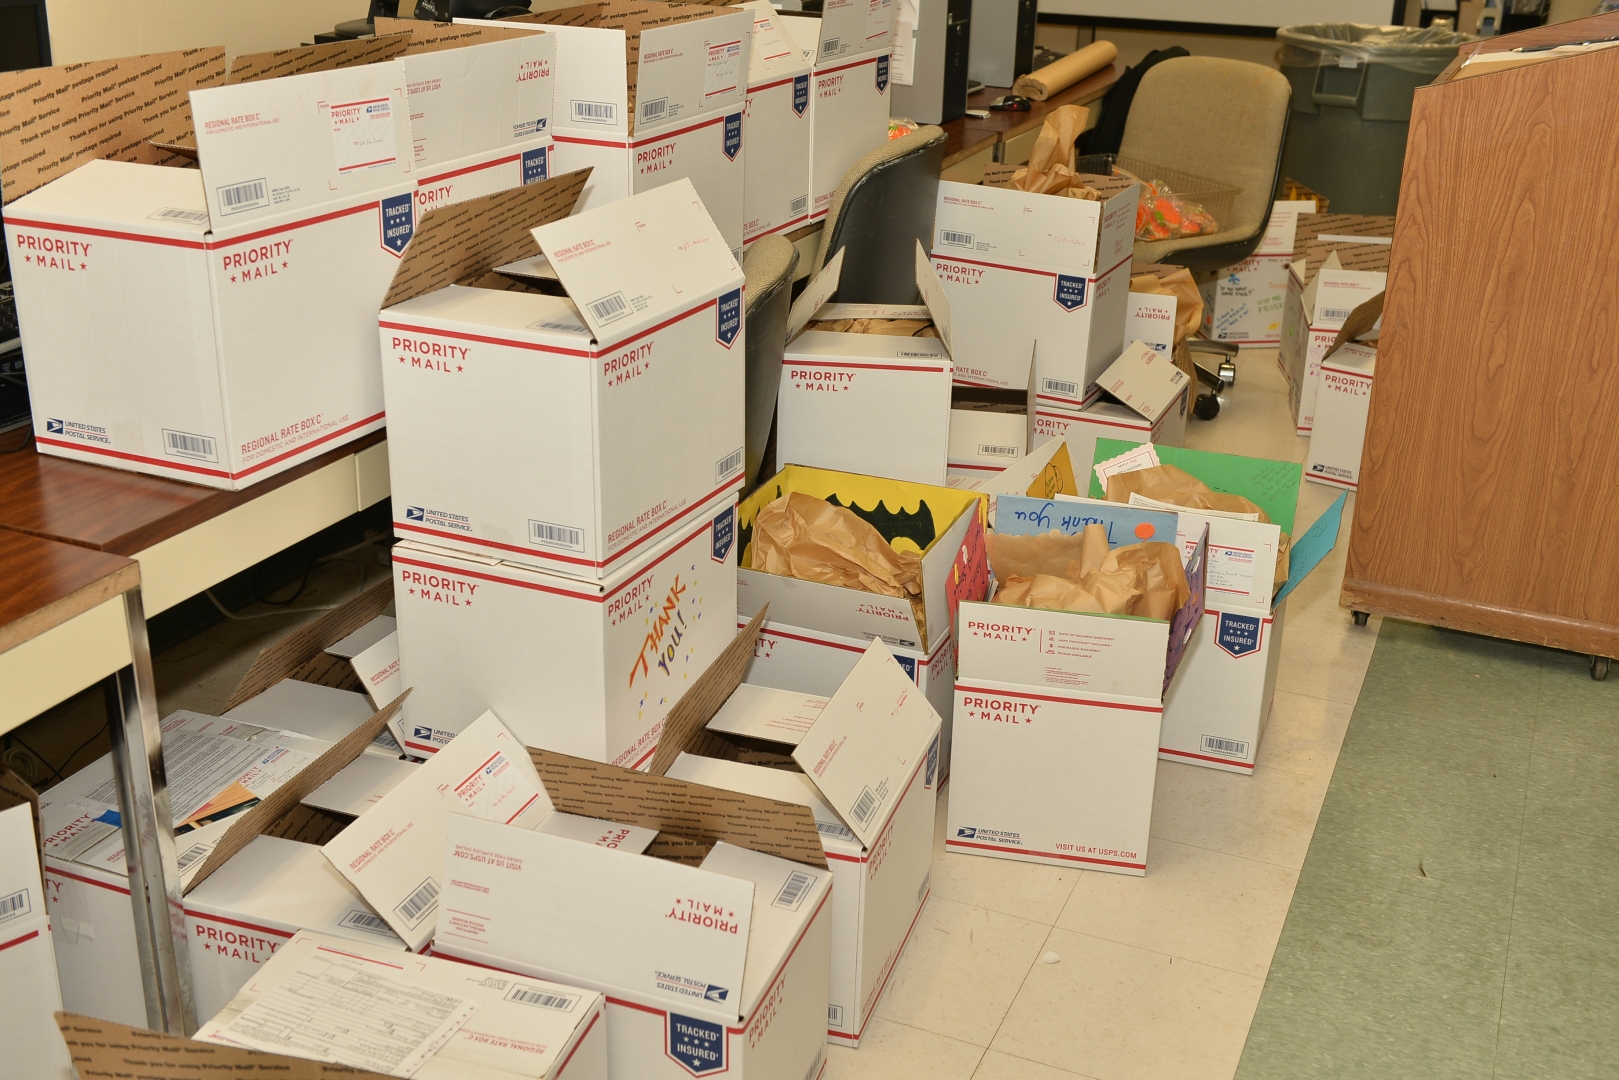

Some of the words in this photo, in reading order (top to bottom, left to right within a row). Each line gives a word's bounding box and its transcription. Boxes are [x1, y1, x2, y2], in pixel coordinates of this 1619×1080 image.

[526, 60, 542, 70] MAIL
[118, 74, 139, 88] postage
[140, 63, 162, 78] required
[517, 68, 550, 82] PRIORITY
[818, 75, 844, 90] PRIORITY
[16, 80, 42, 95] required
[33, 92, 55, 105] Priority
[72, 75, 94, 90] postage
[96, 64, 118, 78] required
[824, 90, 837, 98] MAIL
[20, 133, 39, 146] Thank
[78, 106, 99, 120] Priority
[114, 91, 135, 104] Service
[38, 108, 60, 120] Service
[69, 130, 87, 142] Thank
[124, 104, 144, 117] Priority
[158, 90, 178, 102] Service
[142, 113, 159, 124] Thank
[331, 108, 361, 118] PRIORITY
[205, 116, 230, 129] REGIONAL
[340, 117, 355, 126] MAIL
[726, 120, 740, 132] TRACKED
[21, 149, 46, 164] required
[38, 158, 59, 174] Priority
[76, 142, 98, 157] postage
[99, 130, 122, 146] required
[638, 143, 676, 164] PRIORITY
[525, 157, 545, 168] TRACKED
[646, 161, 666, 174] MAIL
[418, 186, 452, 206] ORITY
[386, 203, 410, 218] TRACKED
[386, 225, 412, 239] INSURED
[17, 234, 90, 257] PRIORITY
[223, 239, 293, 270] PRIORITY
[36, 254, 75, 271] MAIL
[242, 262, 278, 284] MAIL
[936, 263, 984, 278] PRIORITY
[946, 274, 972, 285] MAIL
[1061, 280, 1083, 288] TRACKED
[1060, 292, 1082, 302] INSURED
[720, 299, 738, 312] TRACKED
[720, 318, 739, 328] INSURED
[1134, 312, 1170, 321] PRIORITY
[393, 337, 468, 360] PRIORITY
[412, 356, 450, 373] MAIL
[604, 343, 654, 376] PRIORITY
[616, 366, 642, 386] MAIL
[791, 370, 854, 382] PRIORITY
[956, 366, 971, 375] RATE
[971, 368, 982, 376] BOX
[806, 382, 838, 392] MAIL
[1325, 374, 1372, 390] PRIORITY
[1335, 385, 1359, 396] MAIL
[64, 420, 86, 430] UNITED
[86, 424, 106, 434] STATES
[1035, 418, 1070, 430] ORITY
[64, 430, 86, 440] POSTAL
[241, 434, 280, 454] REGIONAL
[280, 423, 300, 438] RATE
[300, 416, 316, 431] BOX
[242, 454, 255, 464] FOR
[256, 443, 284, 460] DOMESTIC
[284, 436, 296, 446] AND
[298, 420, 338, 440] INTERNATIONAL
[338, 414, 349, 424] USE
[425, 518, 447, 528] POSTAL
[426, 509, 448, 518] UNITED
[448, 513, 469, 522] STATES
[608, 521, 636, 544] REGIONAL
[636, 511, 650, 526] RATE
[651, 504, 662, 519] BOX
[618, 528, 638, 546] DOMESTIC
[648, 505, 678, 526] INTERNATIONAL
[715, 515, 732, 532] TRACKED
[715, 532, 732, 550] INSURED
[402, 570, 476, 596] PRIORITY
[420, 590, 460, 606] MAIL
[608, 576, 653, 618] PRIORITY
[618, 603, 643, 624] MAIL
[858, 608, 910, 622] PRIORITY
[871, 604, 896, 614] MAIL
[630, 574, 686, 689] THANK
[968, 621, 1033, 635] PRIORITY
[1225, 620, 1255, 630] TRACKED
[983, 632, 1017, 642] MAIL
[1224, 635, 1254, 646] INSURED
[935, 663, 950, 678] MAIL
[964, 697, 1038, 714] PRIORITY
[980, 711, 1020, 724] MAIL
[433, 728, 454, 738] UNITED
[638, 730, 650, 748] RATE
[650, 722, 662, 736] BOX
[457, 774, 484, 798] PRIORITY
[468, 784, 484, 800] MAIL
[60, 823, 88, 842] MAIL
[976, 834, 997, 842] POSTAL
[978, 828, 1000, 836] UNITED
[350, 847, 371, 870] REGIONAL
[370, 840, 382, 854] RATE
[380, 832, 392, 844] BOX
[669, 840, 682, 848] you
[1055, 842, 1074, 851] VISIT
[1087, 846, 1096, 854] AT
[1098, 848, 1137, 859] USPS.COM
[510, 862, 522, 872] VISIT
[687, 898, 724, 916] MAIL
[667, 908, 738, 934] PRIORITY
[195, 925, 278, 954] PRIORITY
[217, 944, 260, 964] MAIL
[656, 982, 680, 994] STATES
[682, 978, 706, 988] POSTAL
[680, 988, 703, 999] UNITED
[749, 972, 788, 1043] PRIORITY
[676, 1023, 717, 1042] TRACKED
[758, 1007, 777, 1043] MAIL
[475, 1036, 490, 1044] BOX
[490, 1039, 508, 1048] RATE
[510, 1043, 545, 1055] REGIONAL
[677, 1043, 716, 1060] INSURED
